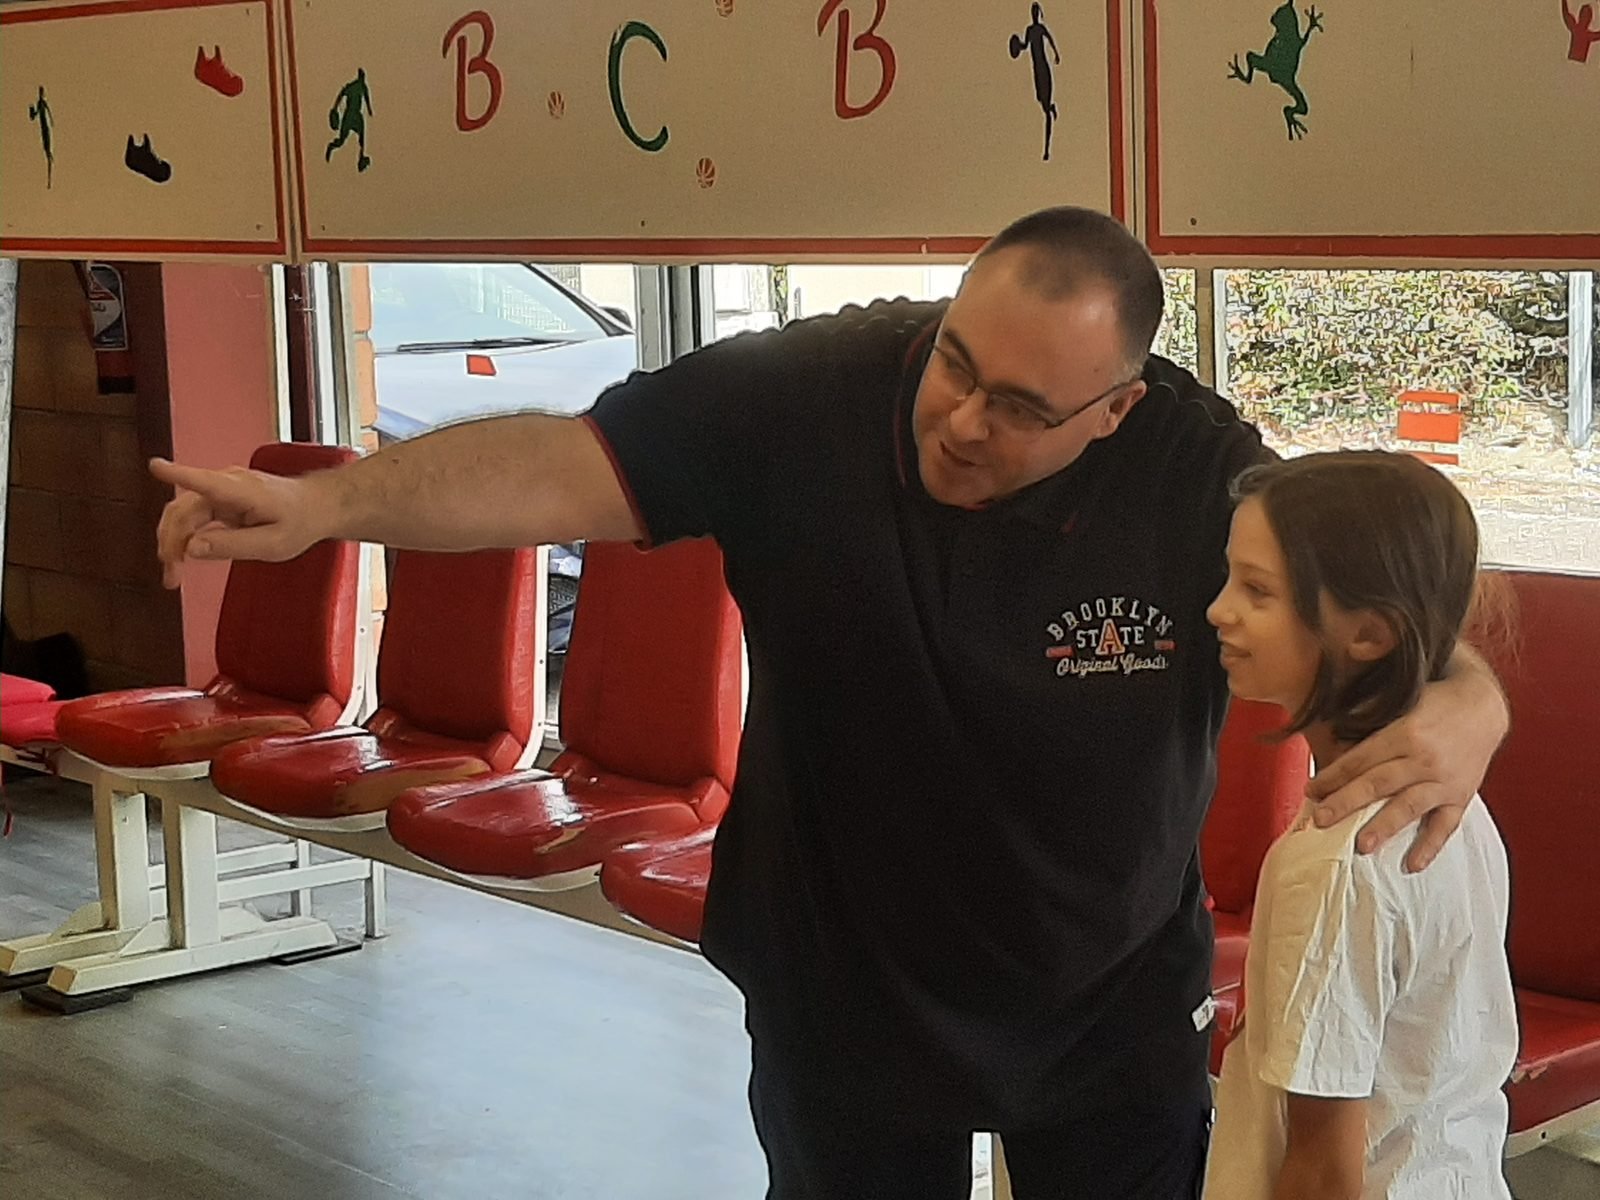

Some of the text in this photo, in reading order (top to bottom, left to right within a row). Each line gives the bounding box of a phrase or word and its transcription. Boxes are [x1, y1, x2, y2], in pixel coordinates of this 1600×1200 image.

[442, 0, 896, 152] B C B
[1046, 597, 1173, 641] BROOKLYN
[1076, 618, 1145, 655] STATE
[1056, 652, 1168, 677] Original Goods
